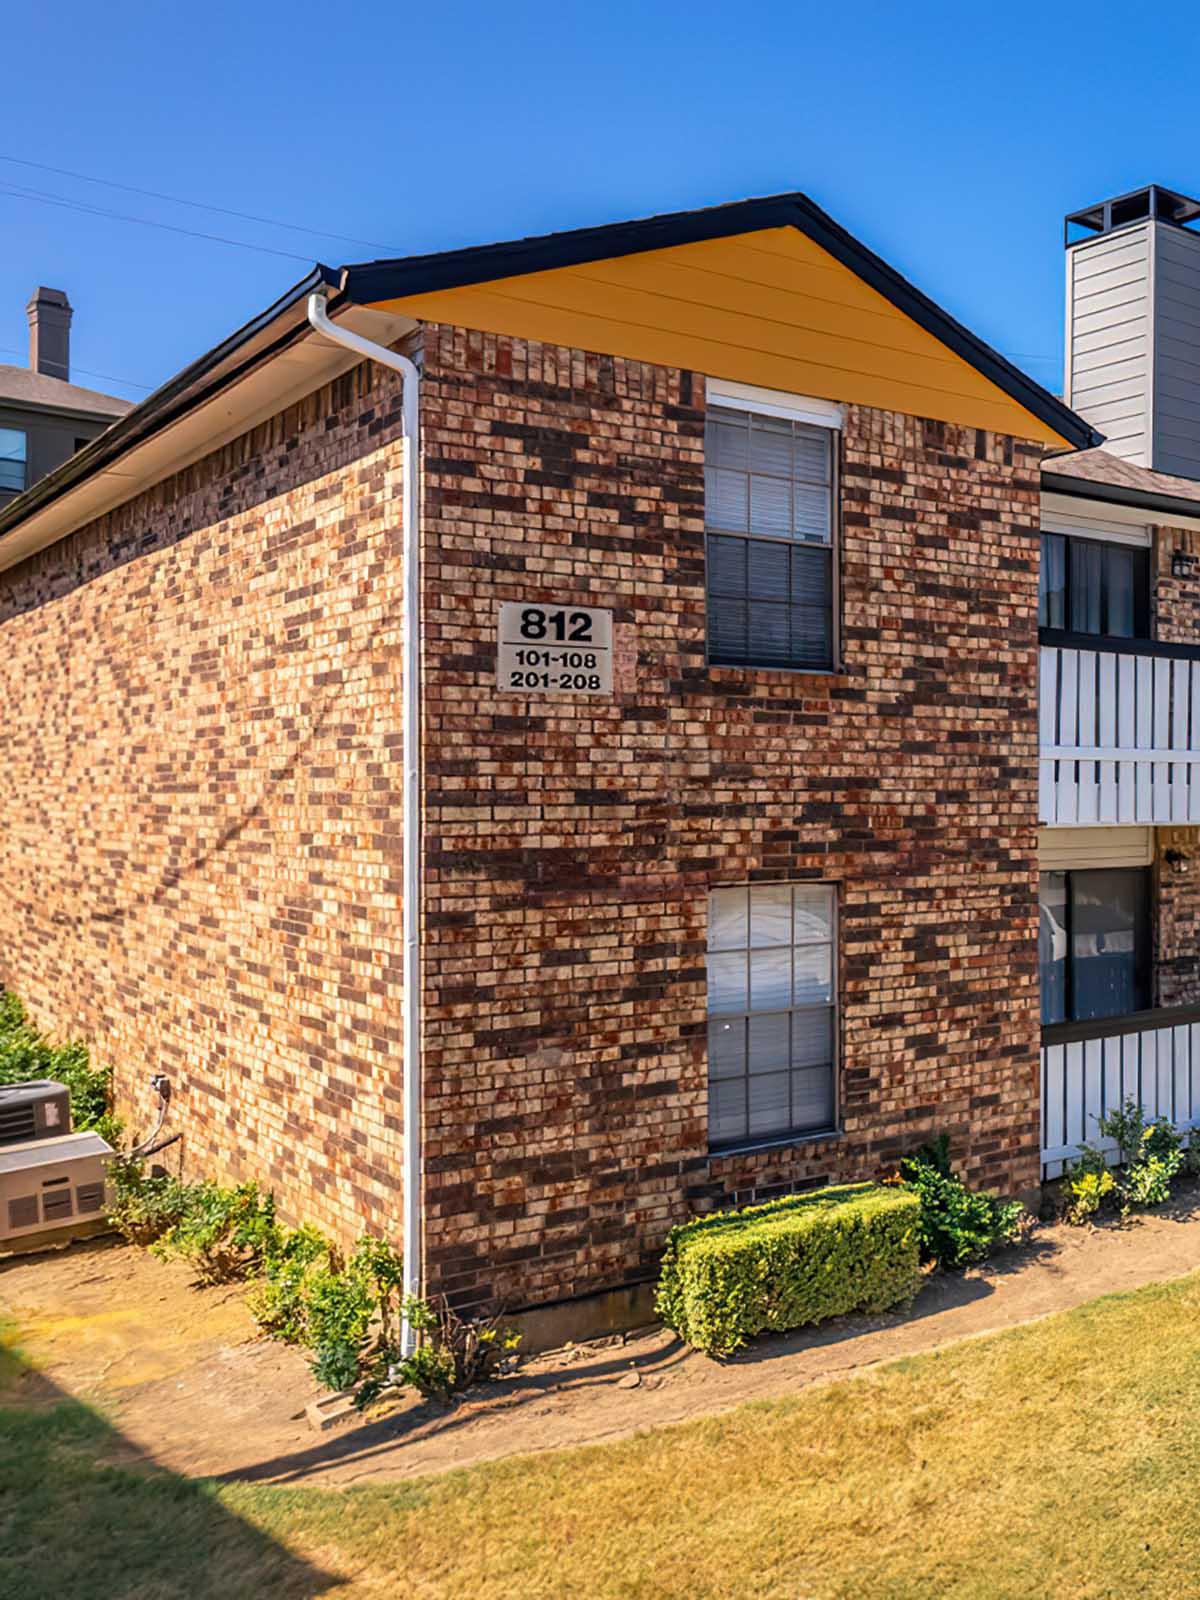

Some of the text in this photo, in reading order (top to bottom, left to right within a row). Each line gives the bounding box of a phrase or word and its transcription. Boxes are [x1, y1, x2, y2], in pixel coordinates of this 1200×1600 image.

[520, 609, 592, 642] 812
[516, 650, 596, 669] 101-108
[510, 672, 600, 689] 201-208
